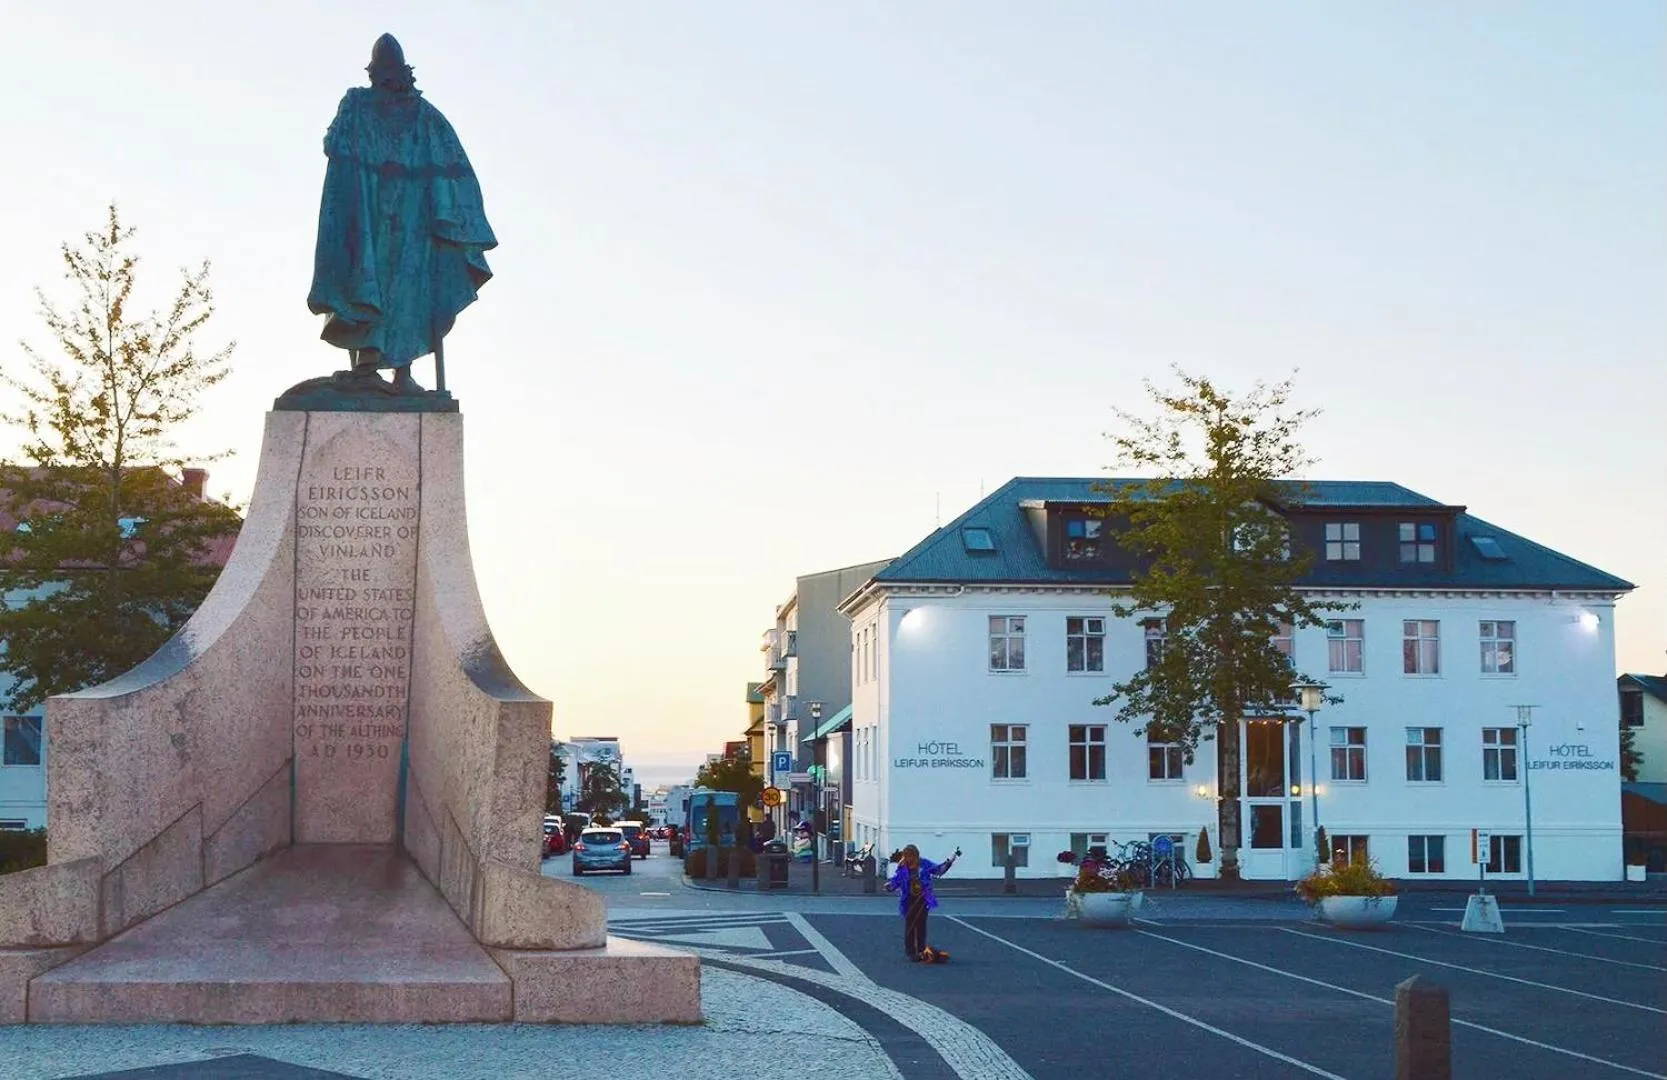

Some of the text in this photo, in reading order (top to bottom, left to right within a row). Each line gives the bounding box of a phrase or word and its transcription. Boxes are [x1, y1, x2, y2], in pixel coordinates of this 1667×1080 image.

[333, 467, 385, 480] LEIFR
[308, 486, 409, 500] EIRICSSON
[298, 506, 416, 520] SON OF ICELAND
[299, 525, 418, 539] DISCOVERER OF
[319, 544, 395, 558] VINLAND
[341, 568, 370, 581] THE
[298, 587, 415, 601] UNITED STATES
[297, 607, 412, 621] OF AMERICA TO
[302, 626, 406, 640] THE PEOPLE
[300, 645, 406, 660] OF ICELAND
[299, 665, 406, 679] ON THE ONE
[299, 684, 406, 698] THOUSANDTH
[297, 703, 403, 718] ANNIVERSARY
[296, 724, 404, 738] OF THE ALTHING
[918, 740, 963, 755] HÓTEL
[1549, 743, 1594, 757] HÓTEL
[778, 757, 787, 769] P
[894, 756, 984, 768] LEIFUR EIRÍKSSON
[1527, 760, 1561, 770] LEIFUR
[765, 791, 778, 802] 30
